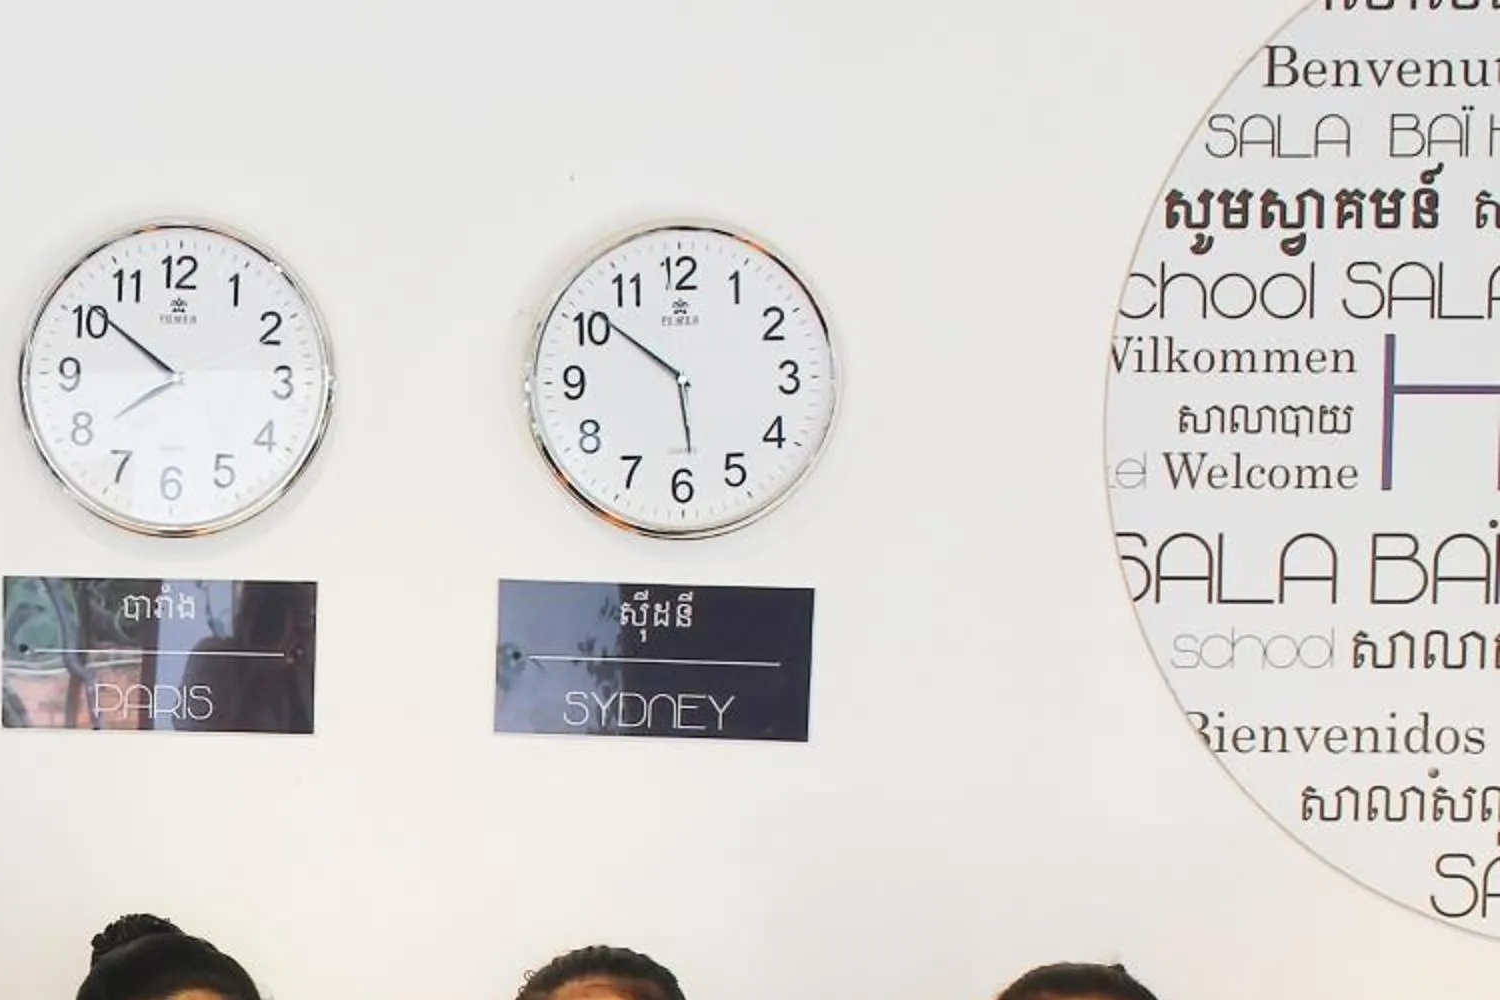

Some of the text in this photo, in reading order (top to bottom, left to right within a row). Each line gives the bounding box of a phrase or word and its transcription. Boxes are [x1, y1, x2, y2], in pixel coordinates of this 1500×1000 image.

[1263, 44, 1500, 88] Benvenu
[1205, 113, 1351, 158] SALA
[112, 268, 142, 304] 11
[161, 254, 199, 290] 12
[228, 272, 240, 308] 1
[612, 272, 641, 308] 11
[660, 255, 698, 291] 12
[728, 269, 740, 305] 1
[1342, 261, 1500, 320] SAL
[72, 304, 109, 339] 10
[259, 310, 283, 346] 2
[573, 311, 610, 347] 10
[762, 306, 786, 341] 2
[58, 356, 82, 392] 9
[272, 365, 294, 400] 3
[562, 365, 587, 401] 9
[778, 359, 801, 396] 3
[71, 411, 93, 446] 8
[253, 420, 277, 453] 4
[579, 419, 601, 455] 8
[762, 415, 786, 449] 4
[111, 450, 132, 484] 7
[160, 466, 183, 501] 6
[214, 453, 235, 489] 5
[619, 455, 643, 490] 7
[724, 452, 747, 488] 5
[1162, 452, 1358, 490] Welcome
[671, 467, 695, 505] 6
[1115, 532, 1338, 604] SALA
[1170, 626, 1335, 669] school
[95, 683, 213, 720] PARIS
[563, 691, 735, 731] SYDNEY
